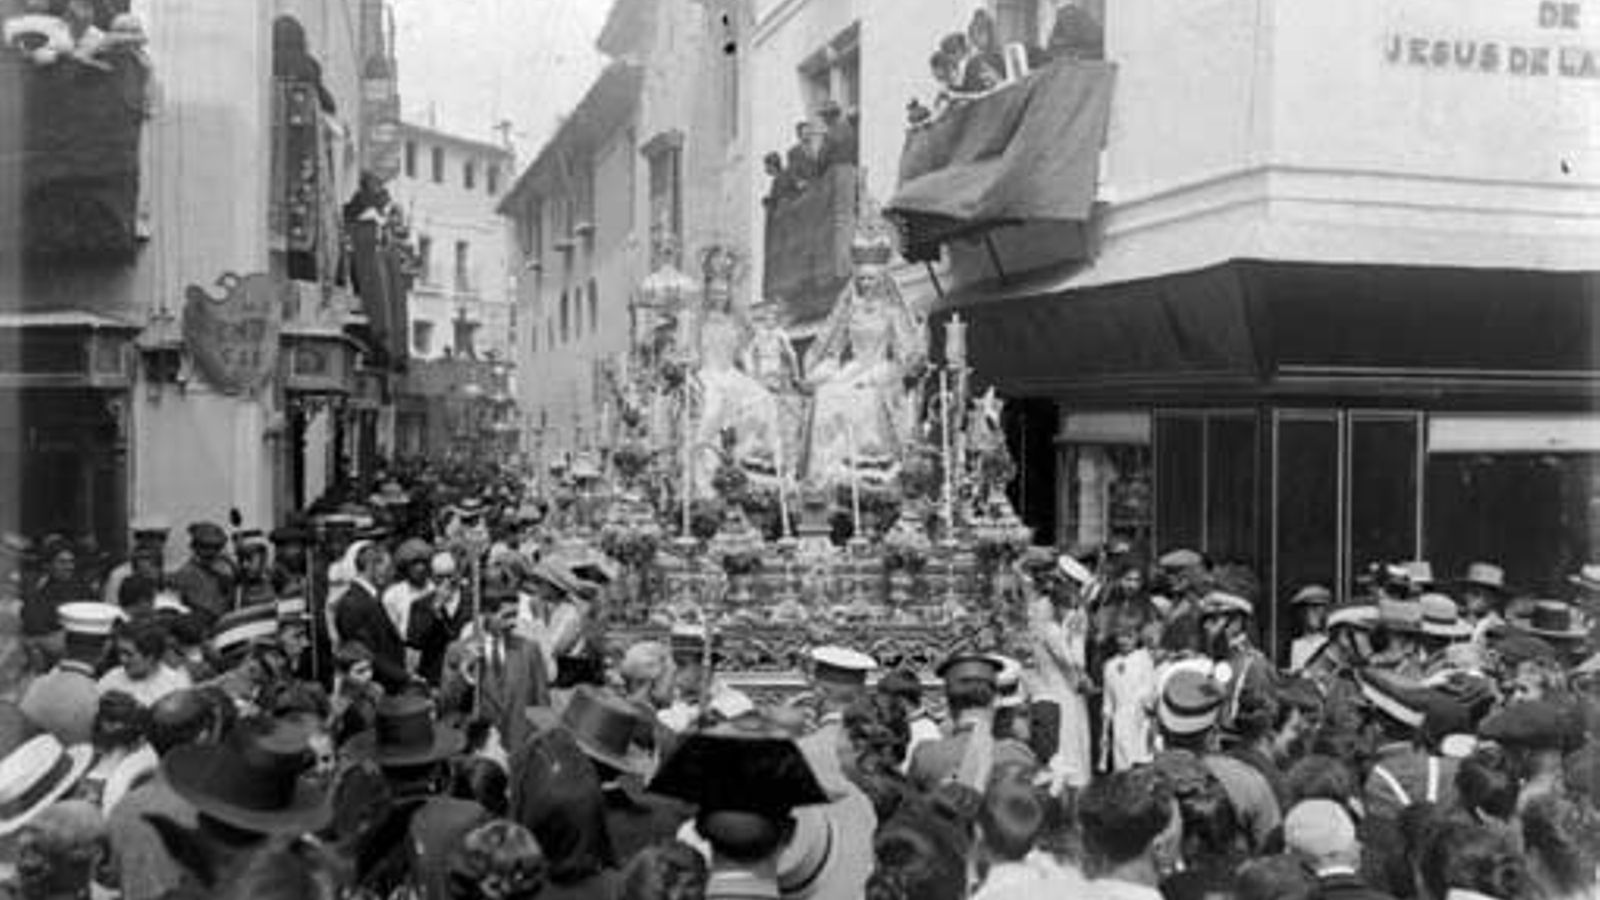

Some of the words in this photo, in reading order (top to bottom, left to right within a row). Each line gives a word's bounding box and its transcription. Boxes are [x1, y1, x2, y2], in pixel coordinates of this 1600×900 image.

[1539, 0, 1580, 29] DE
[1386, 34, 1500, 73] JESUS
[1509, 46, 1549, 76] DE
